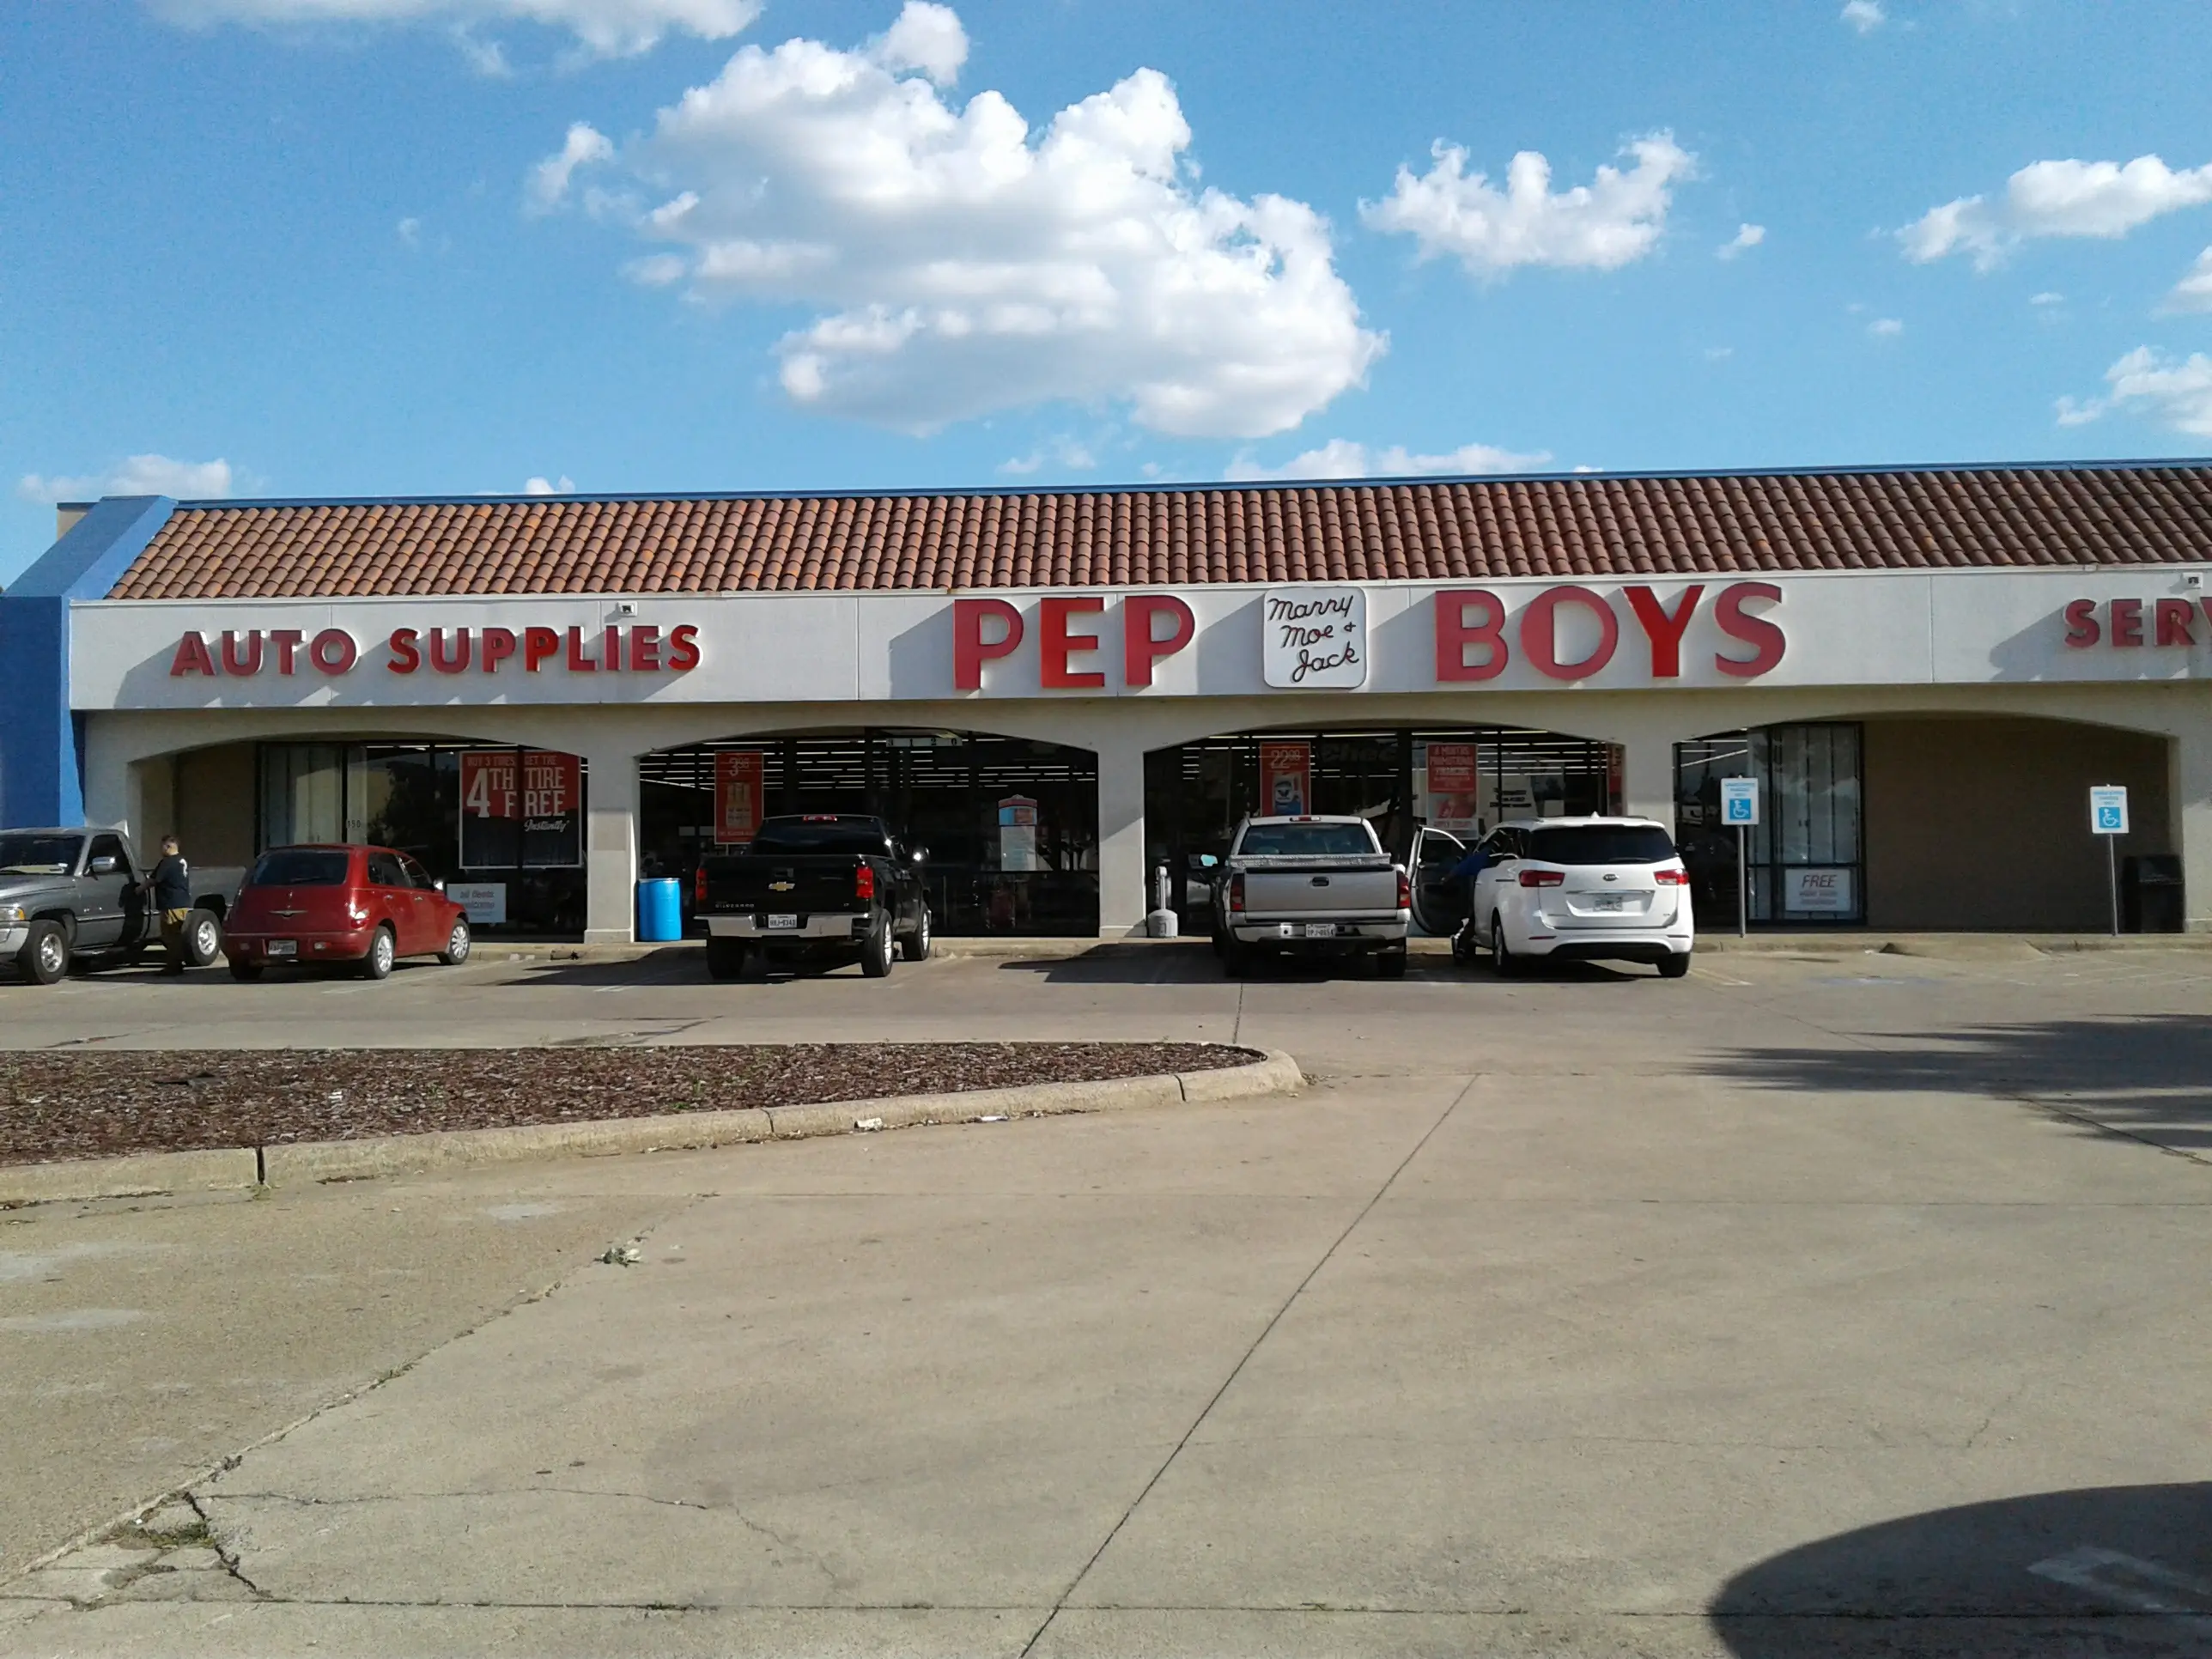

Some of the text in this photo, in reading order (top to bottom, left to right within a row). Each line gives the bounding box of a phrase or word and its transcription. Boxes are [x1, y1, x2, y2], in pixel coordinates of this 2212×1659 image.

[1267, 595, 1354, 621] Manny
[2063, 597, 2212, 648] SER
[170, 625, 702, 676] AUTO SUPPLIES
[954, 582, 1786, 689] PEP BOYS
[1280, 624, 1334, 648] Moe
[1292, 641, 1360, 683] Jack
[467, 756, 483, 767] BUY
[485, 757, 491, 767] 3
[525, 756, 539, 766] GET
[466, 766, 565, 818] 4TH TIRE
[1802, 874, 1838, 889] FREE
